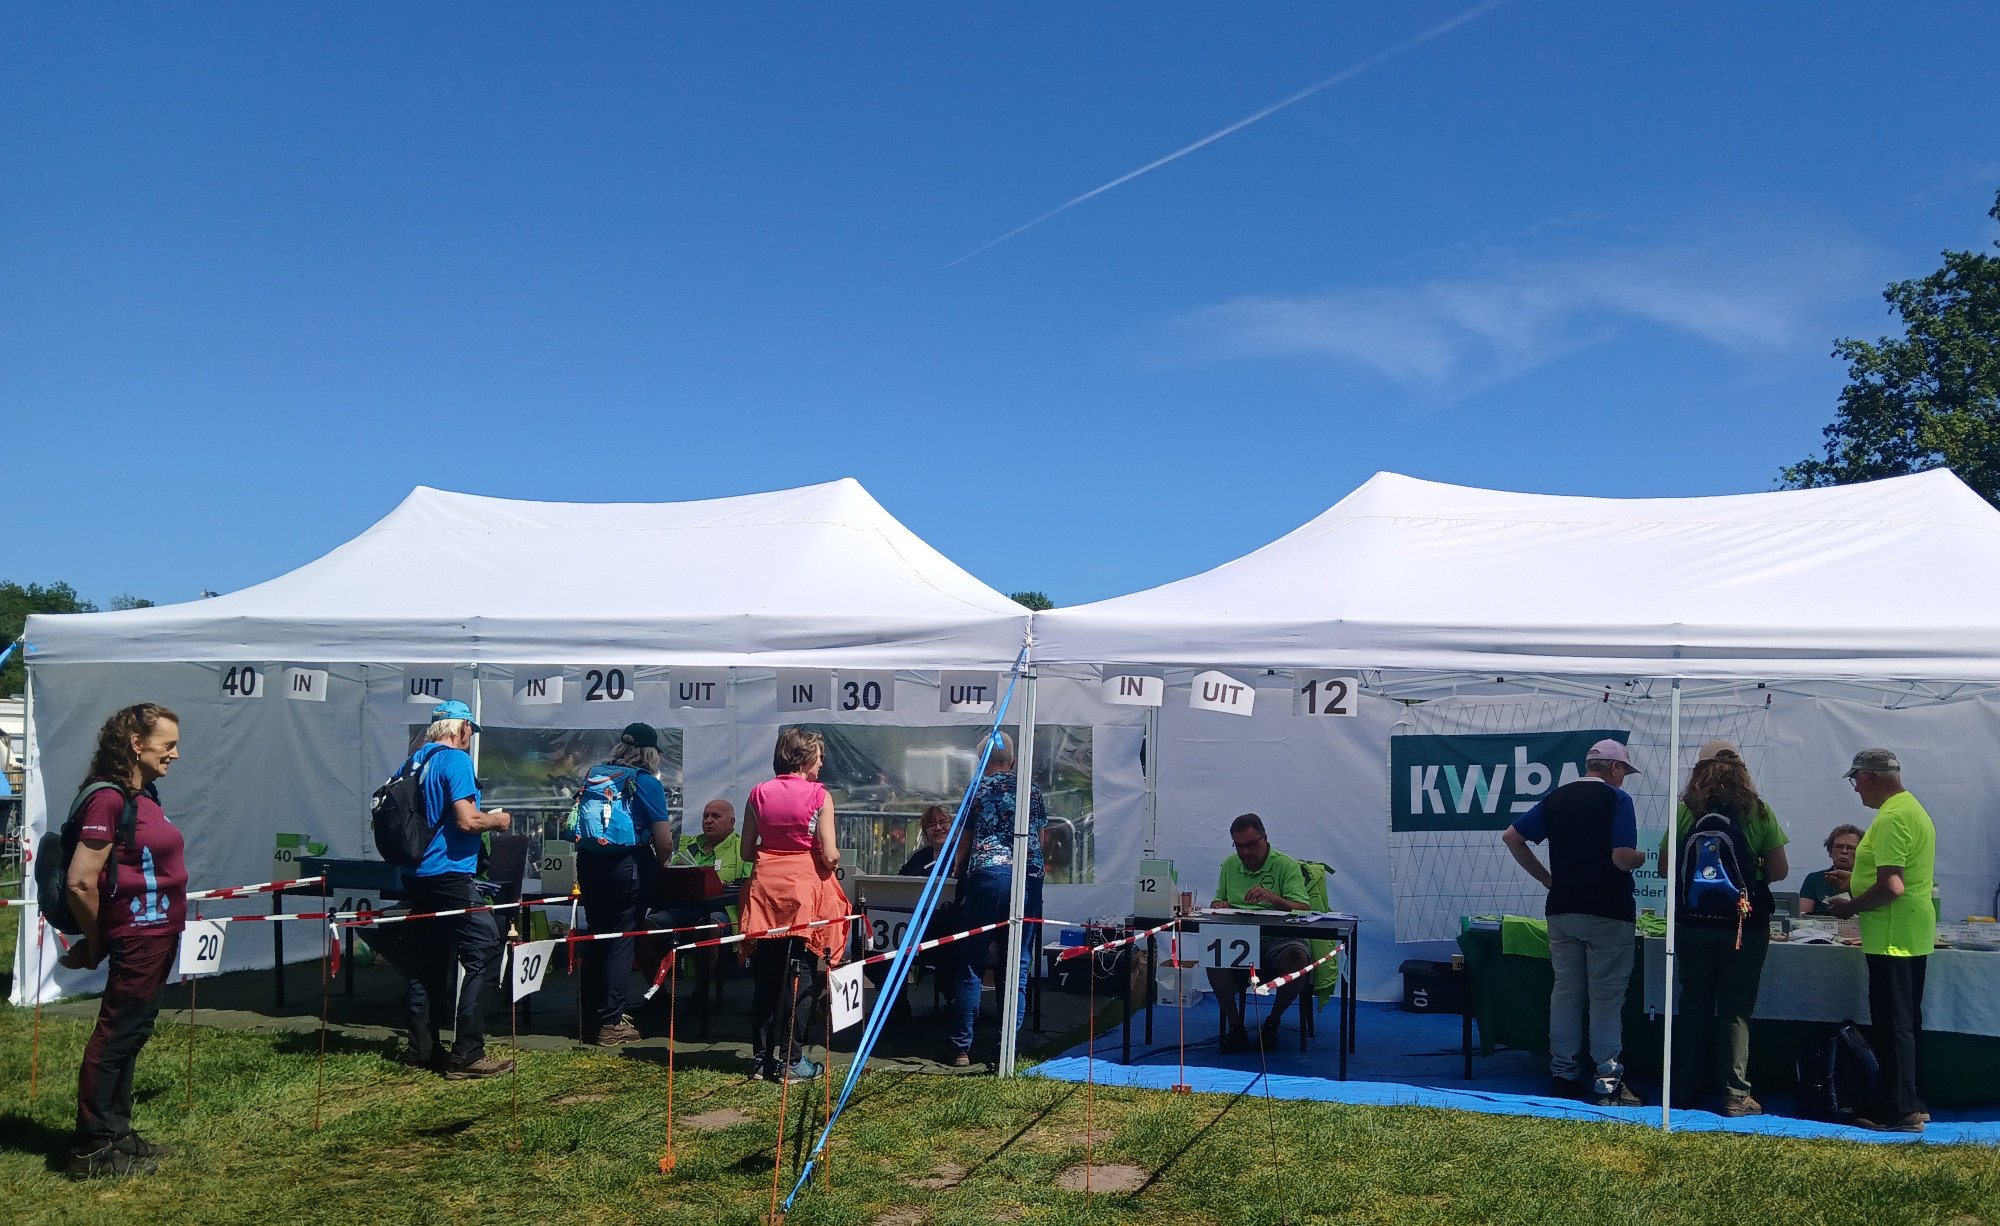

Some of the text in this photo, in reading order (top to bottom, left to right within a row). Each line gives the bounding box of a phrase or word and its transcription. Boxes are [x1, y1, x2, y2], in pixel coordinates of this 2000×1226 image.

[222, 666, 256, 696] 40
[293, 674, 312, 692] IN
[410, 678, 443, 696] UIT
[527, 678, 546, 697] IN
[585, 669, 625, 701] 20
[1120, 676, 1144, 697] IN
[679, 682, 716, 701] UIT
[792, 684, 813, 703] IN
[842, 681, 882, 711] 30
[950, 685, 987, 705] UIT
[1202, 681, 1244, 705] UIT
[1301, 679, 1348, 715] 12
[274, 849, 292, 863] 40
[544, 857, 562, 871] 20
[1138, 878, 1156, 893] 12
[339, 896, 372, 927] 40
[197, 934, 218, 961] 20
[1206, 938, 1251, 968] 12
[520, 954, 541, 985] 30
[1058, 972, 1069, 986] 7
[842, 978, 859, 1012] 12
[1413, 988, 1428, 1008] 10
